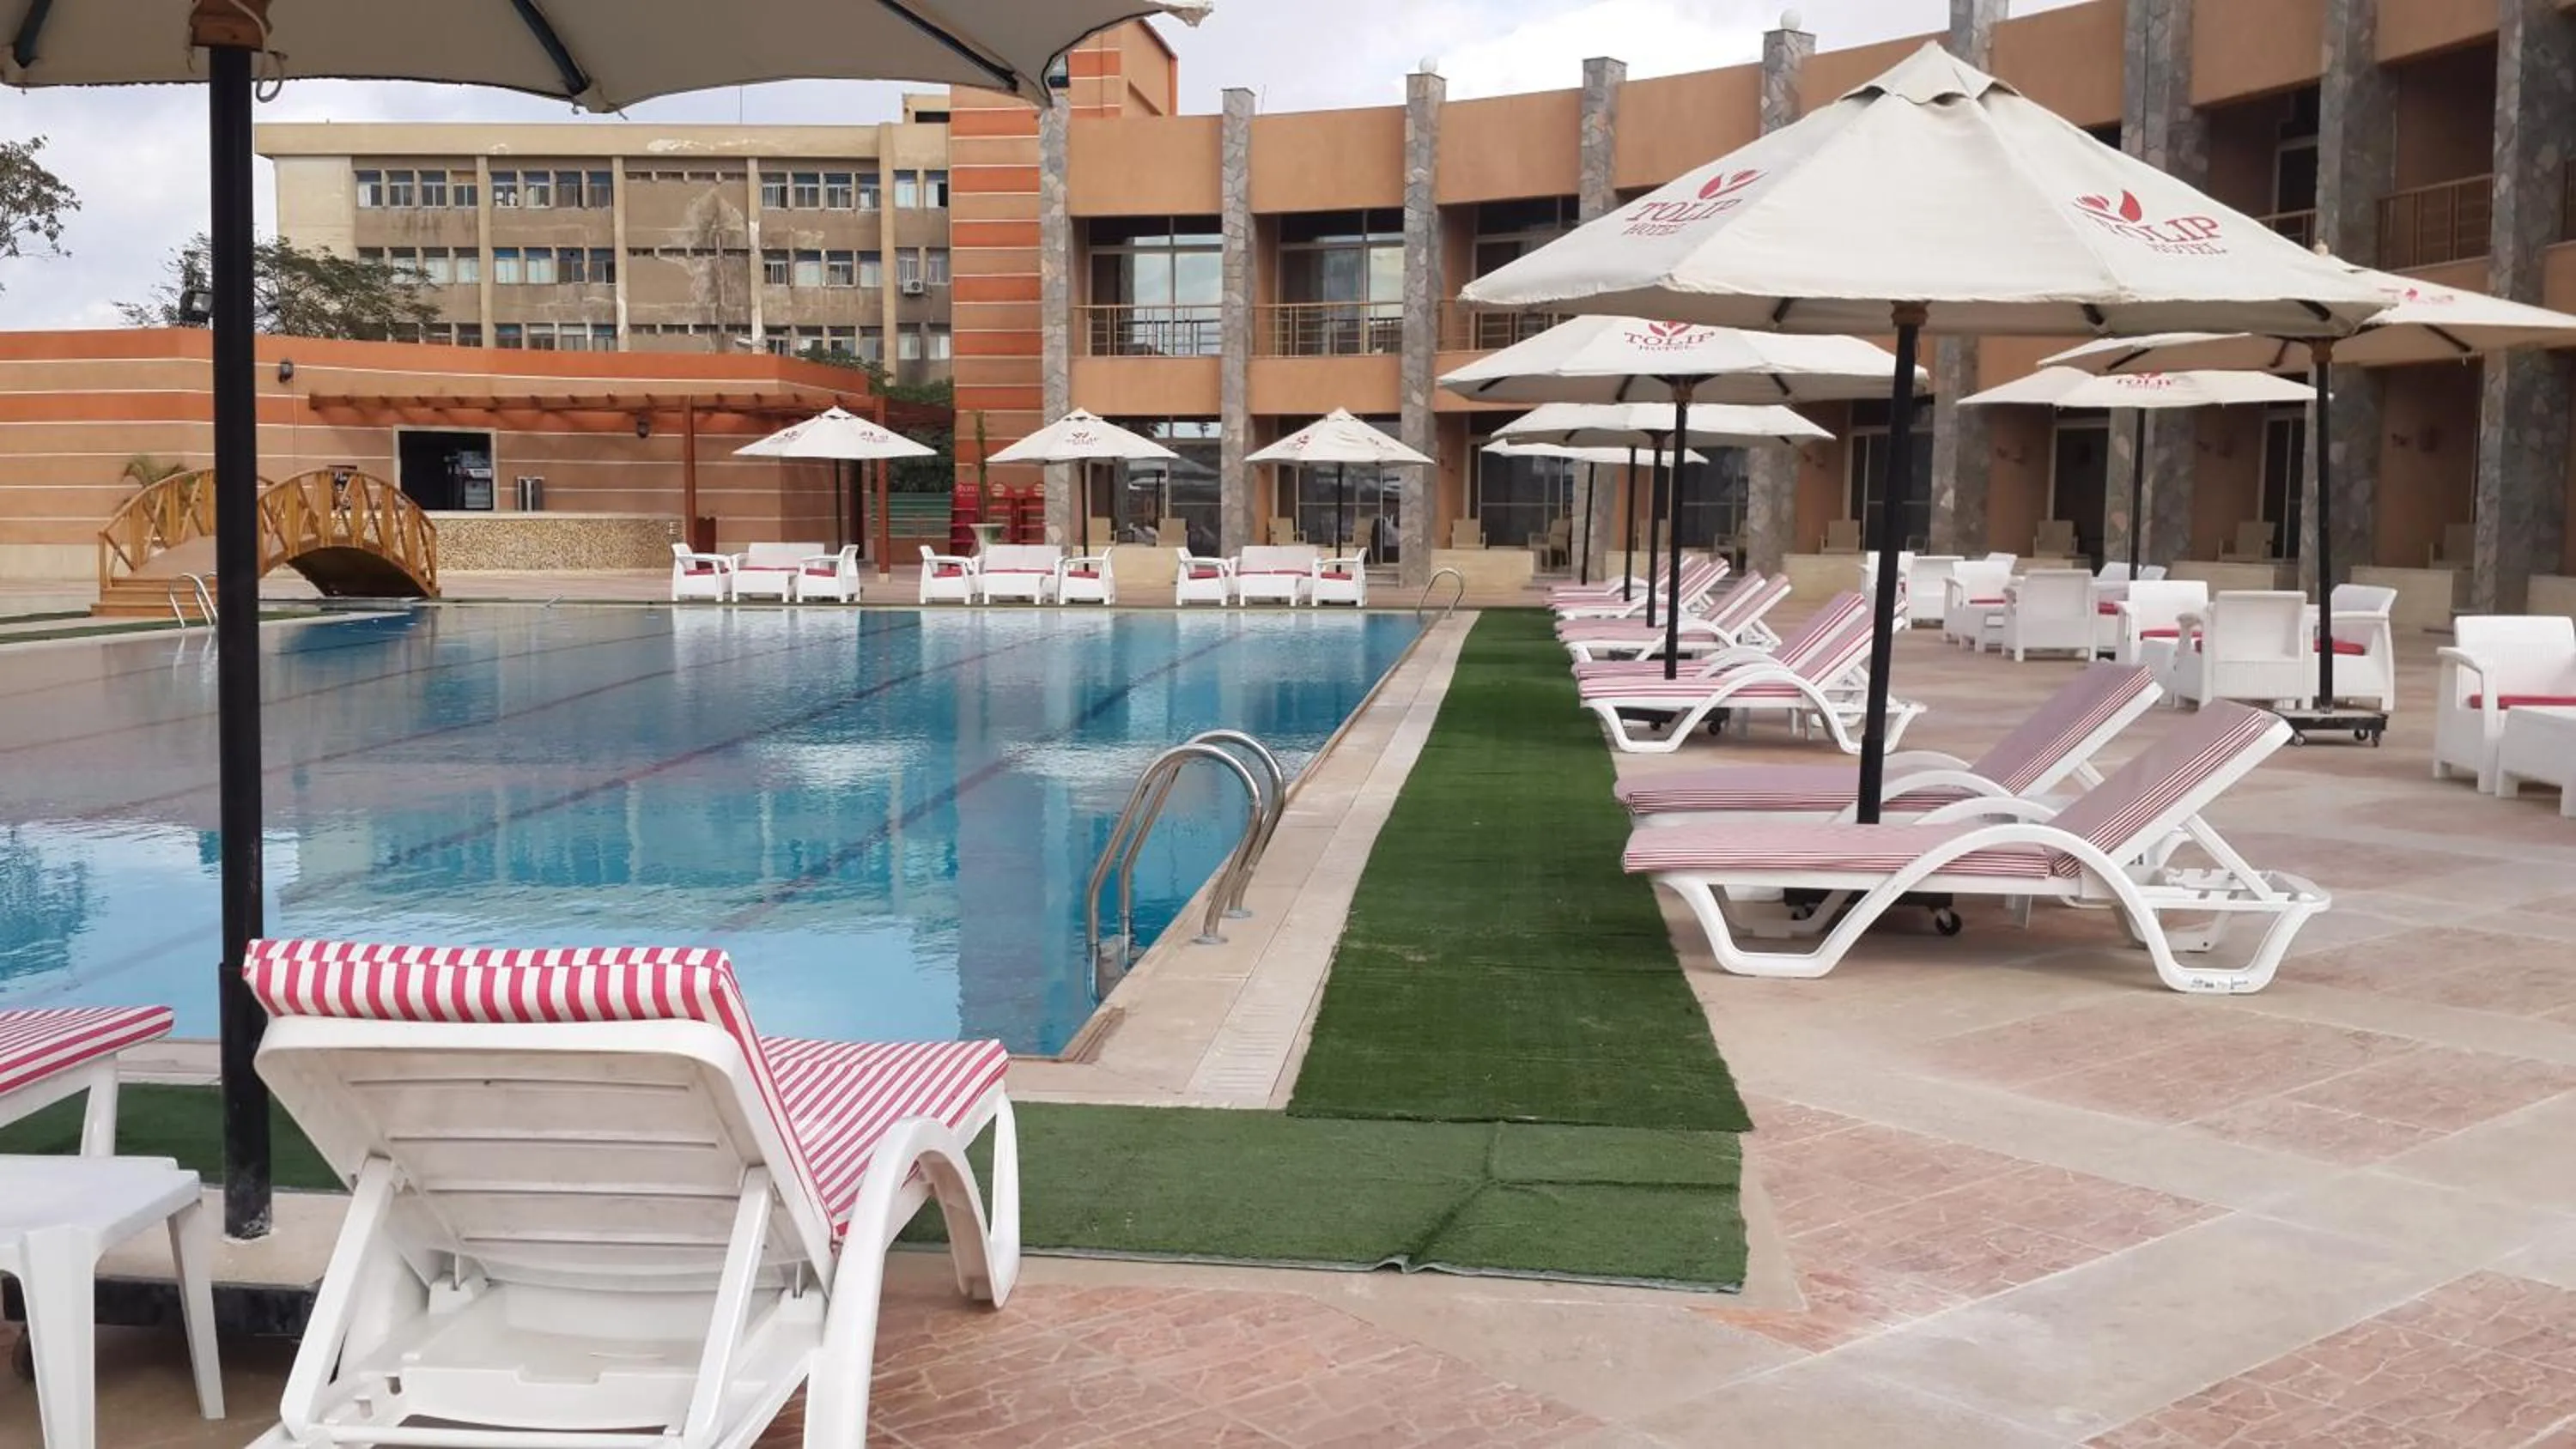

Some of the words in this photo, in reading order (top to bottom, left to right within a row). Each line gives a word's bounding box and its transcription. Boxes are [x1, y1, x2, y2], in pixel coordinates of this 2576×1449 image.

[1625, 197, 1743, 223] TOLIP
[1621, 222, 1686, 237] HOTEL
[1624, 330, 1716, 346] TOLIP
